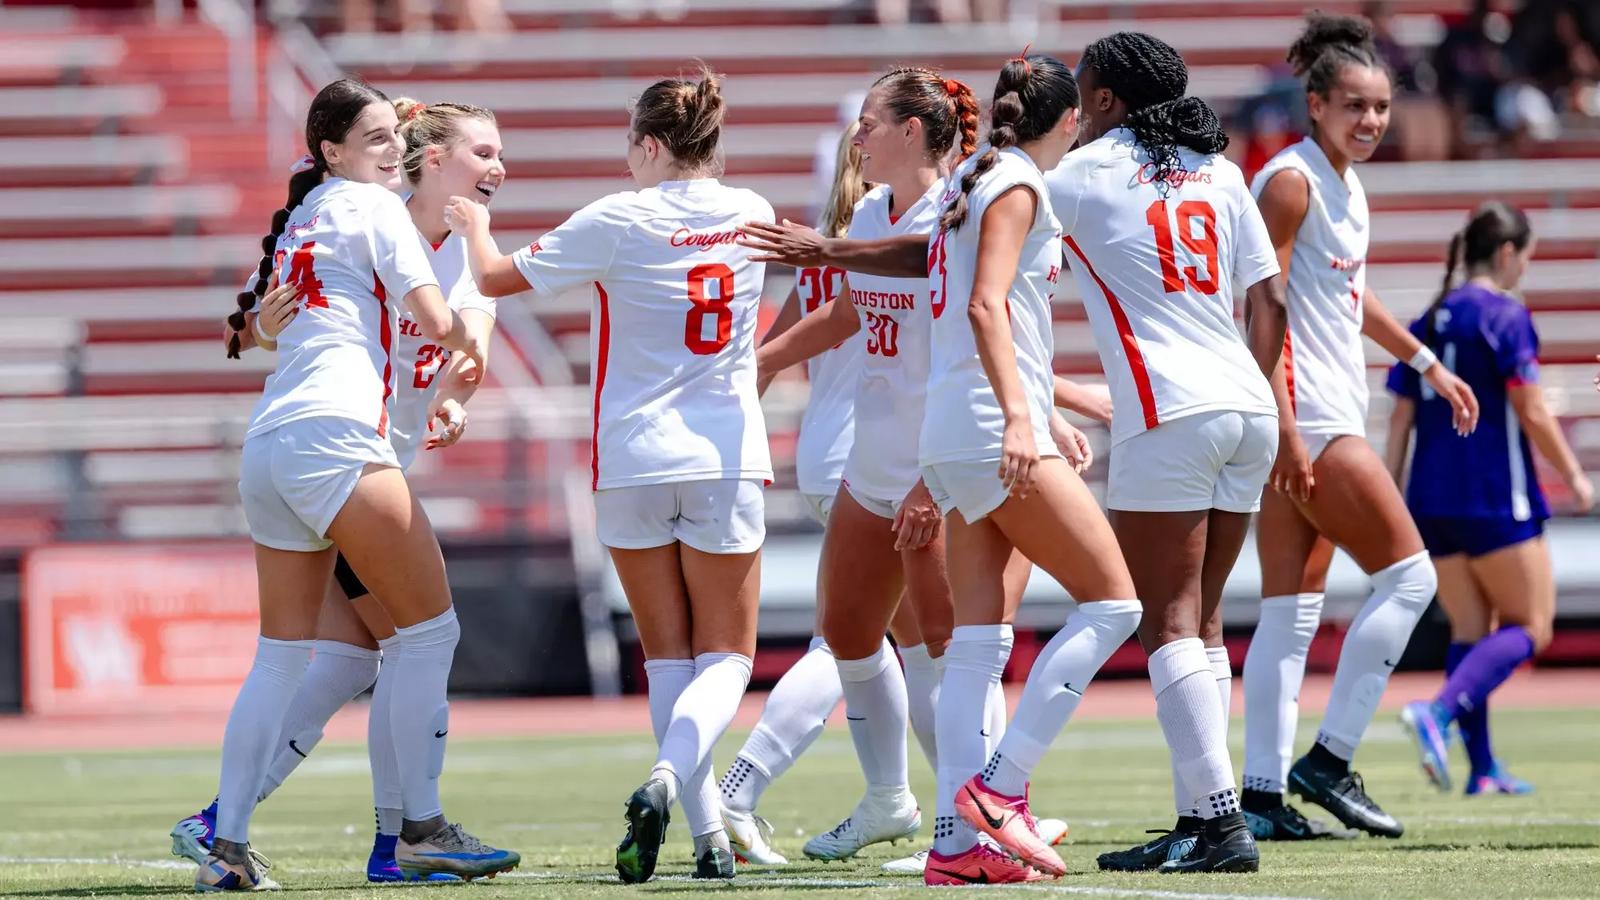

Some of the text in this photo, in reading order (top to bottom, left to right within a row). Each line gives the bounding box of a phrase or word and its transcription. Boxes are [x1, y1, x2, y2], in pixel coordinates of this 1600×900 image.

[1145, 200, 1220, 295] 19
[684, 263, 735, 355] 8
[851, 289, 915, 310] OUSTON
[865, 310, 899, 357] 30
